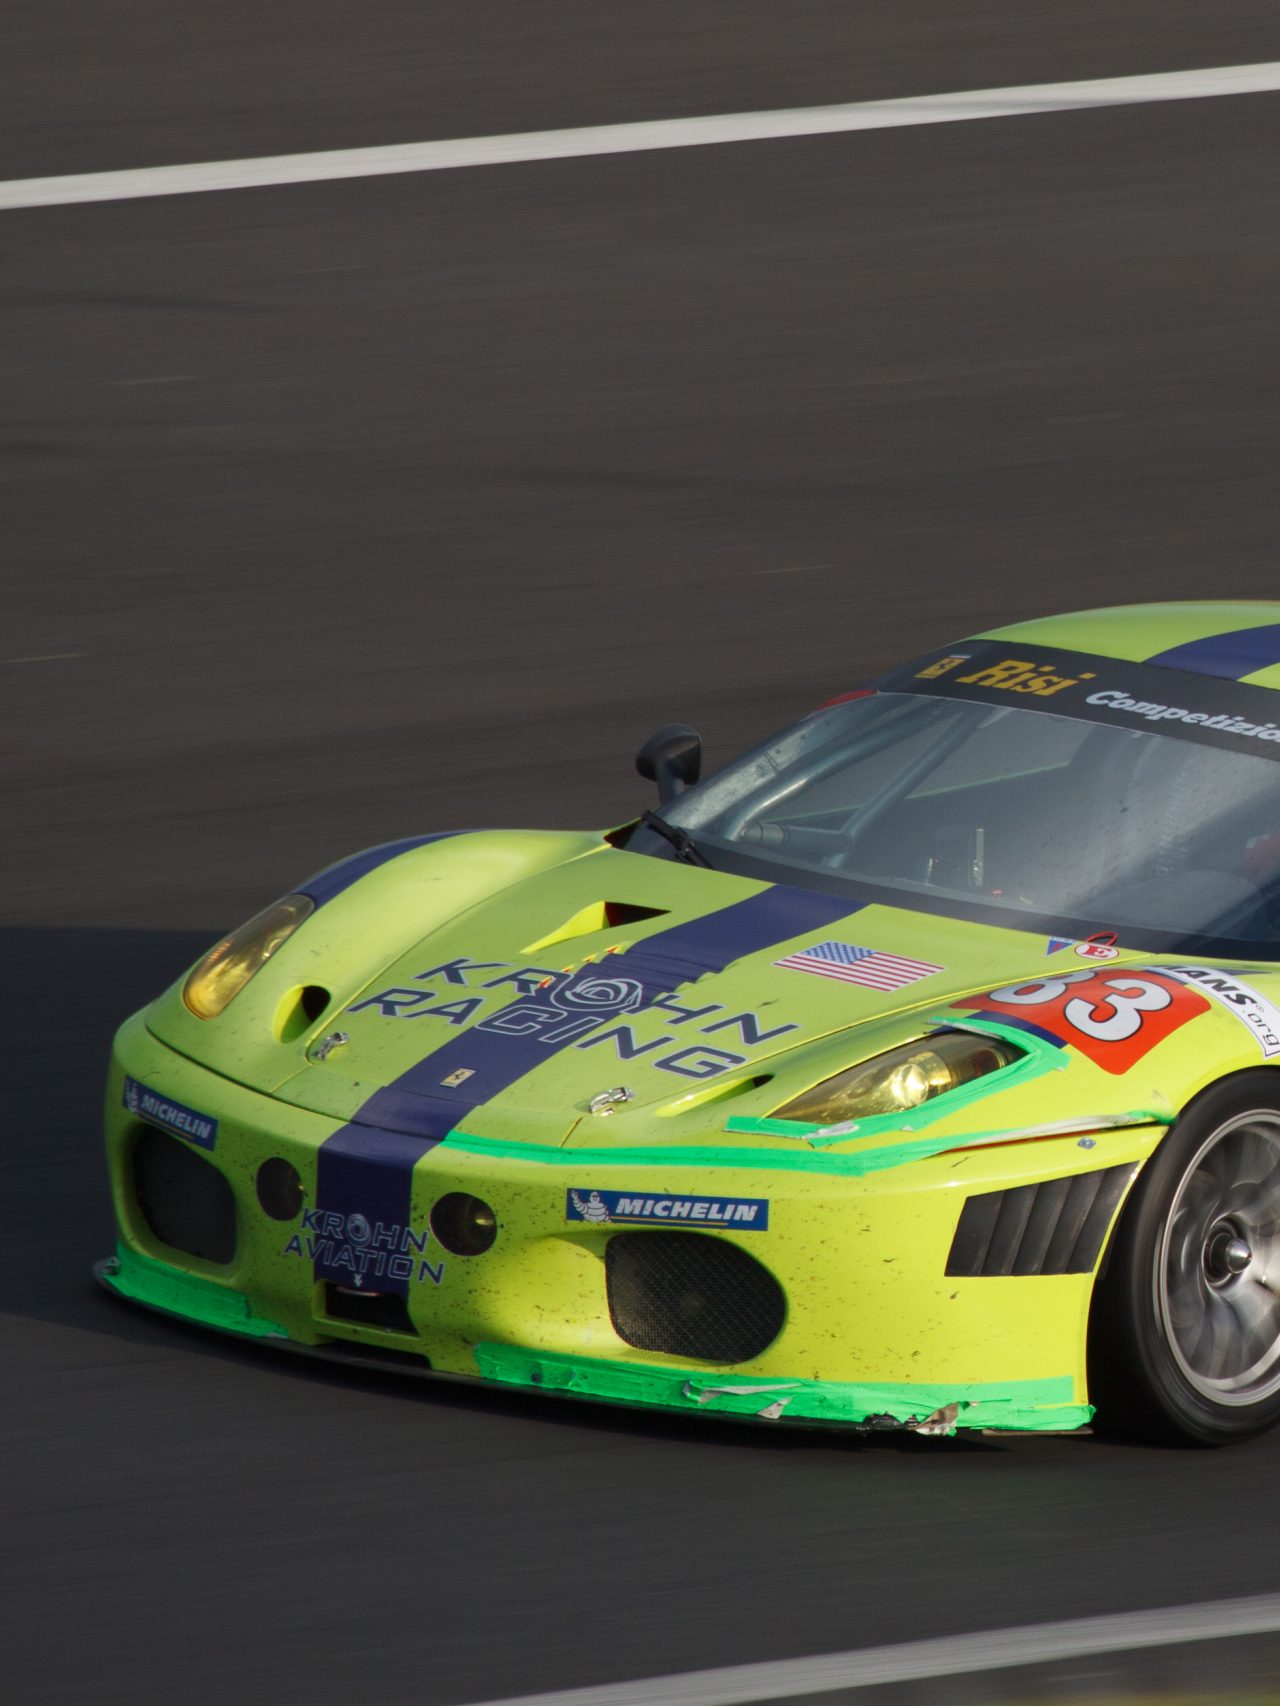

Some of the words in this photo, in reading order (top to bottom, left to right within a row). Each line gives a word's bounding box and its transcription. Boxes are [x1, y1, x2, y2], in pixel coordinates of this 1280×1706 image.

[955, 659, 1098, 697] Risi
[411, 957, 800, 1047] KROHN
[346, 986, 748, 1080] RACING
[140, 1092, 213, 1141] MICHELIN
[300, 1206, 430, 1254] KROHN
[615, 1197, 759, 1222] MICHELIN
[283, 1233, 446, 1286] AVIATION
